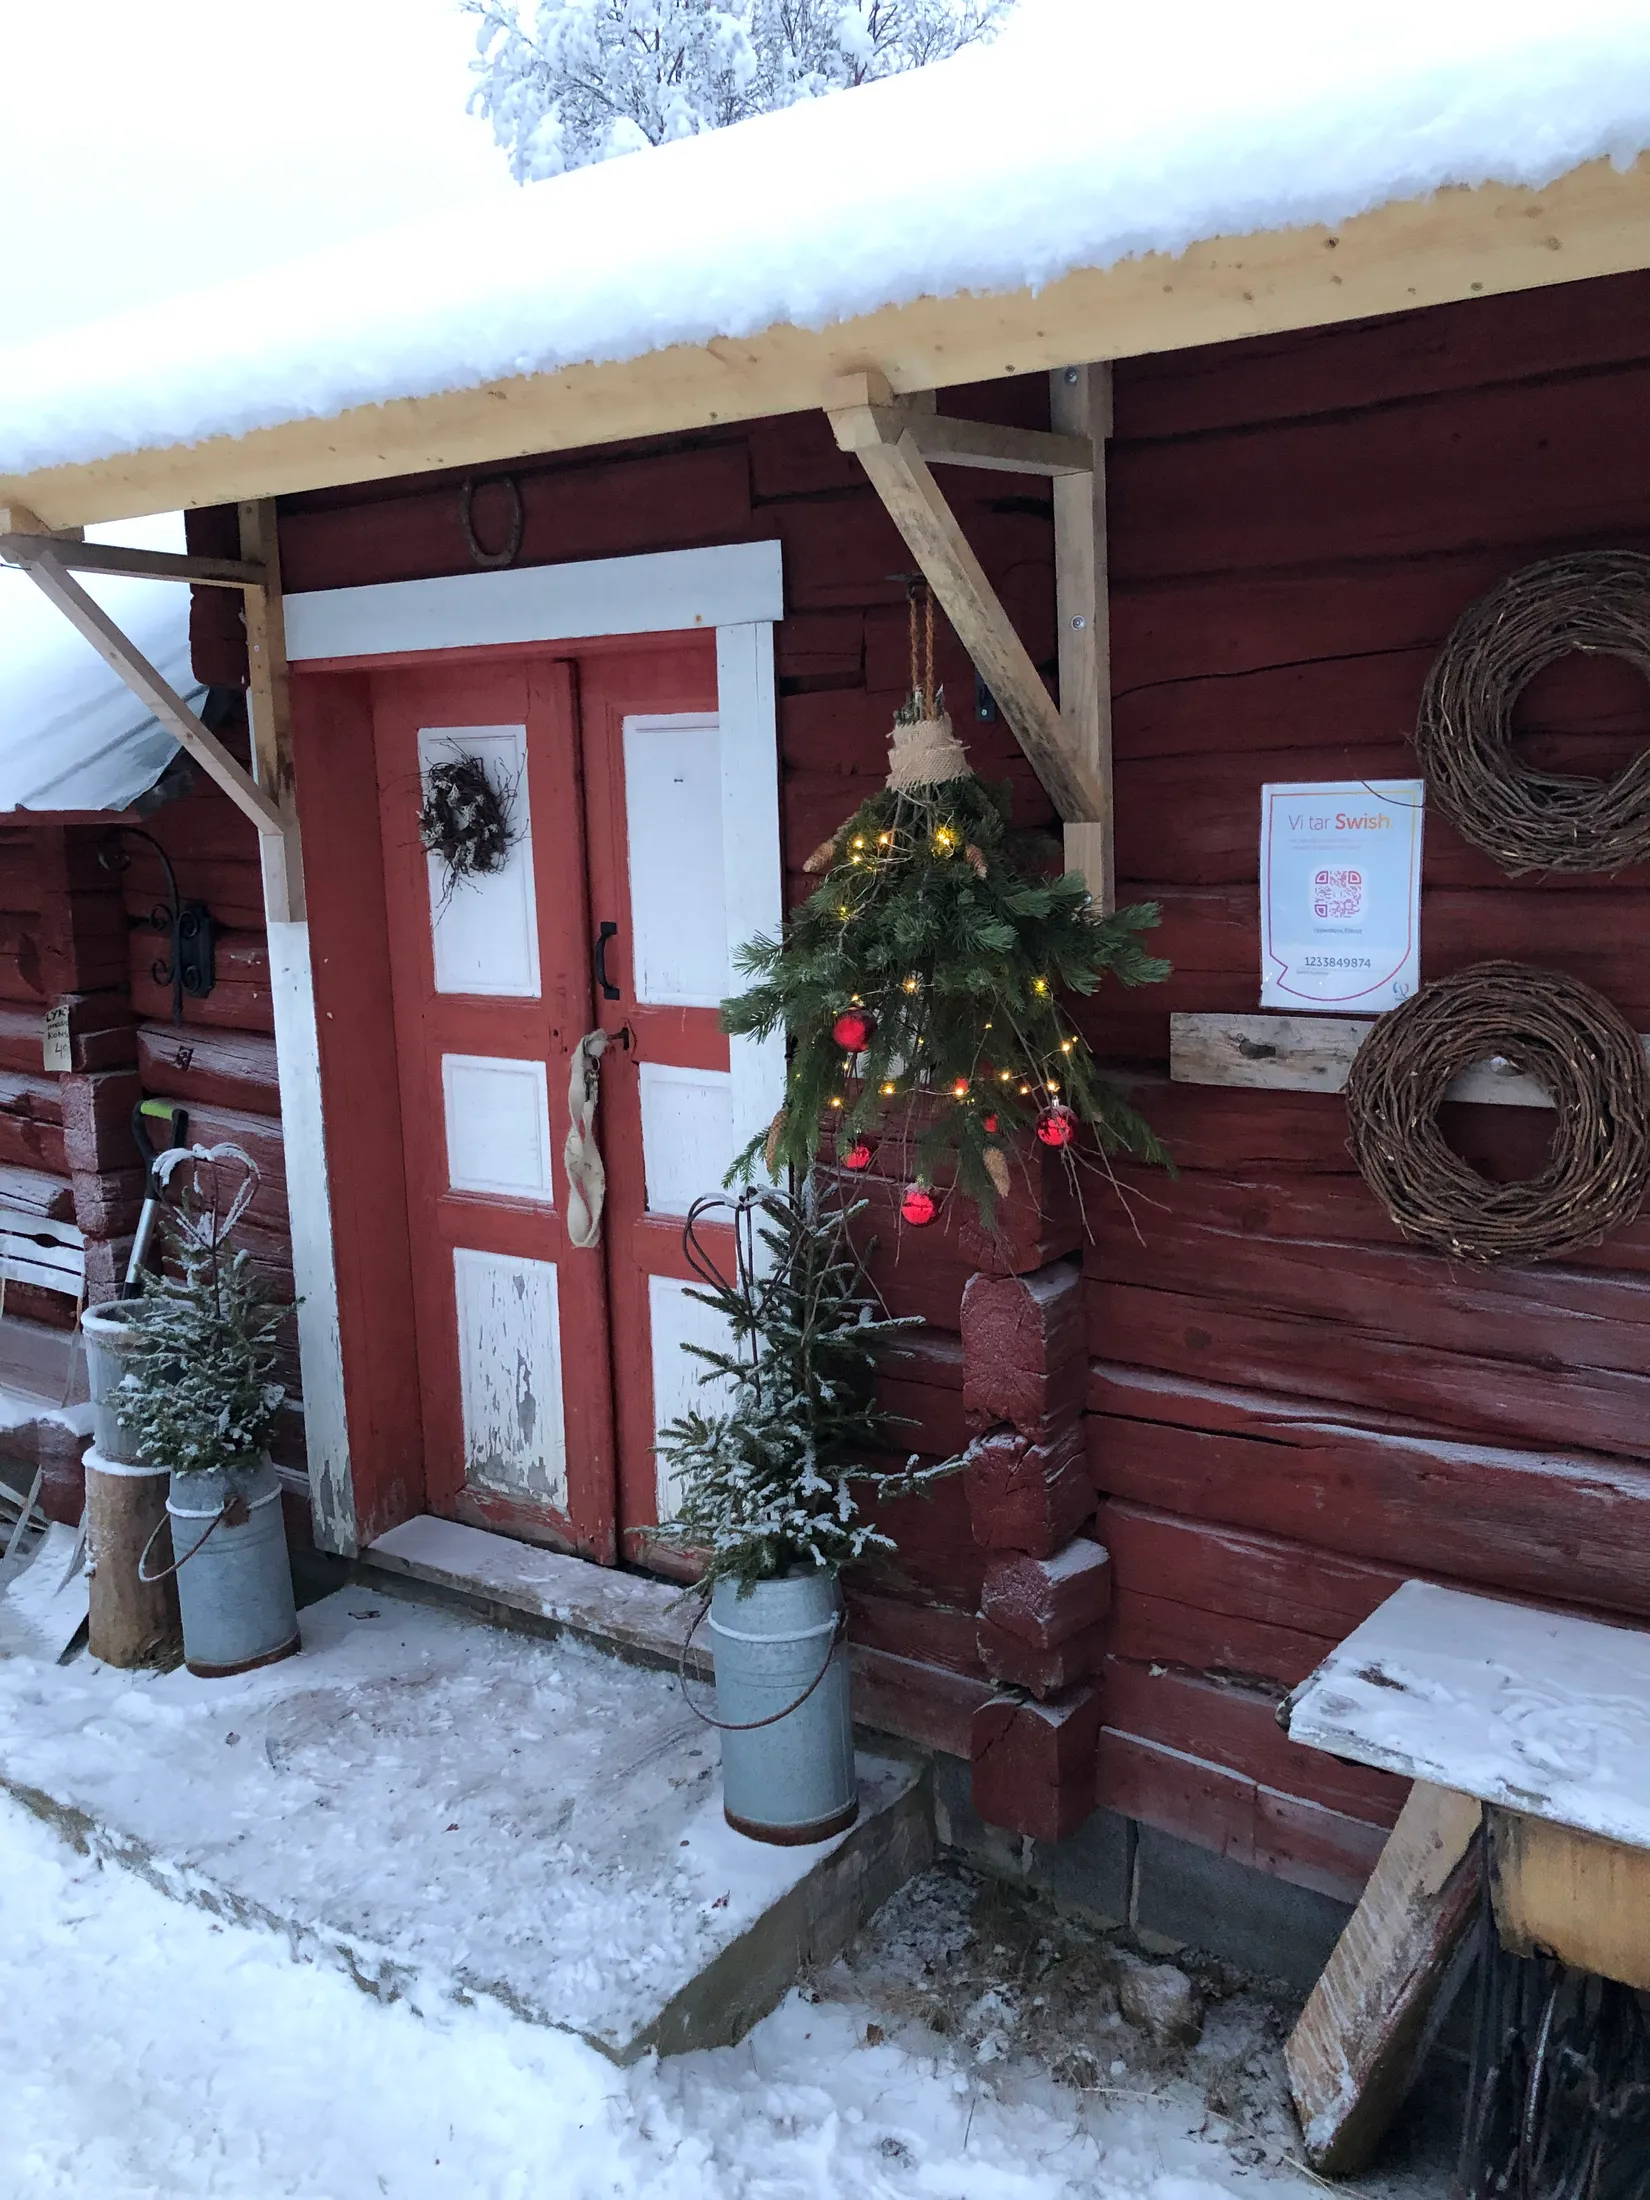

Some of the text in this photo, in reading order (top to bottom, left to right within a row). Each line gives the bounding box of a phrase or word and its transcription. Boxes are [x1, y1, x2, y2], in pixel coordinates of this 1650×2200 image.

[1288, 812, 1391, 830] Vi tar Swish
[1305, 956, 1372, 969] 1233849874
